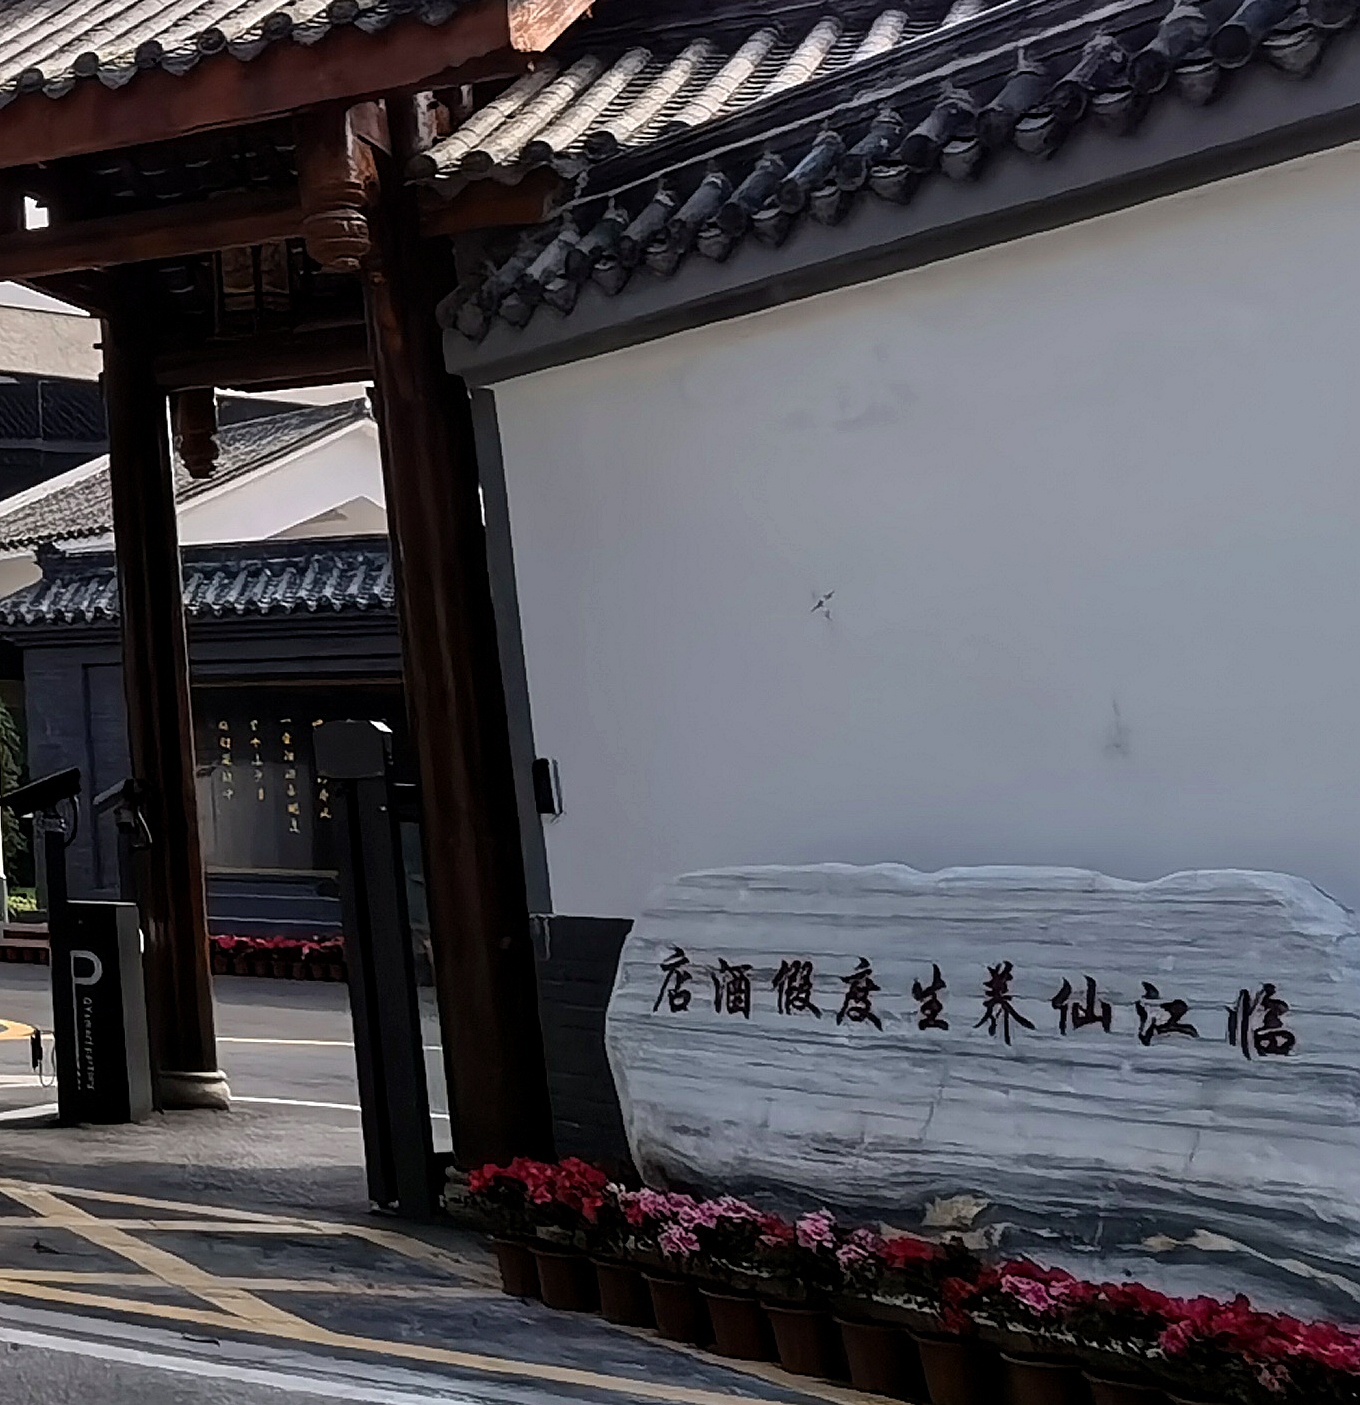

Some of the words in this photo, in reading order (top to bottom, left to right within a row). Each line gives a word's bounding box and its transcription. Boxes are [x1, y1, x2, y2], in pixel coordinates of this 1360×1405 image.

[652, 944, 1298, 1061] 临江仙养生度假酒店
